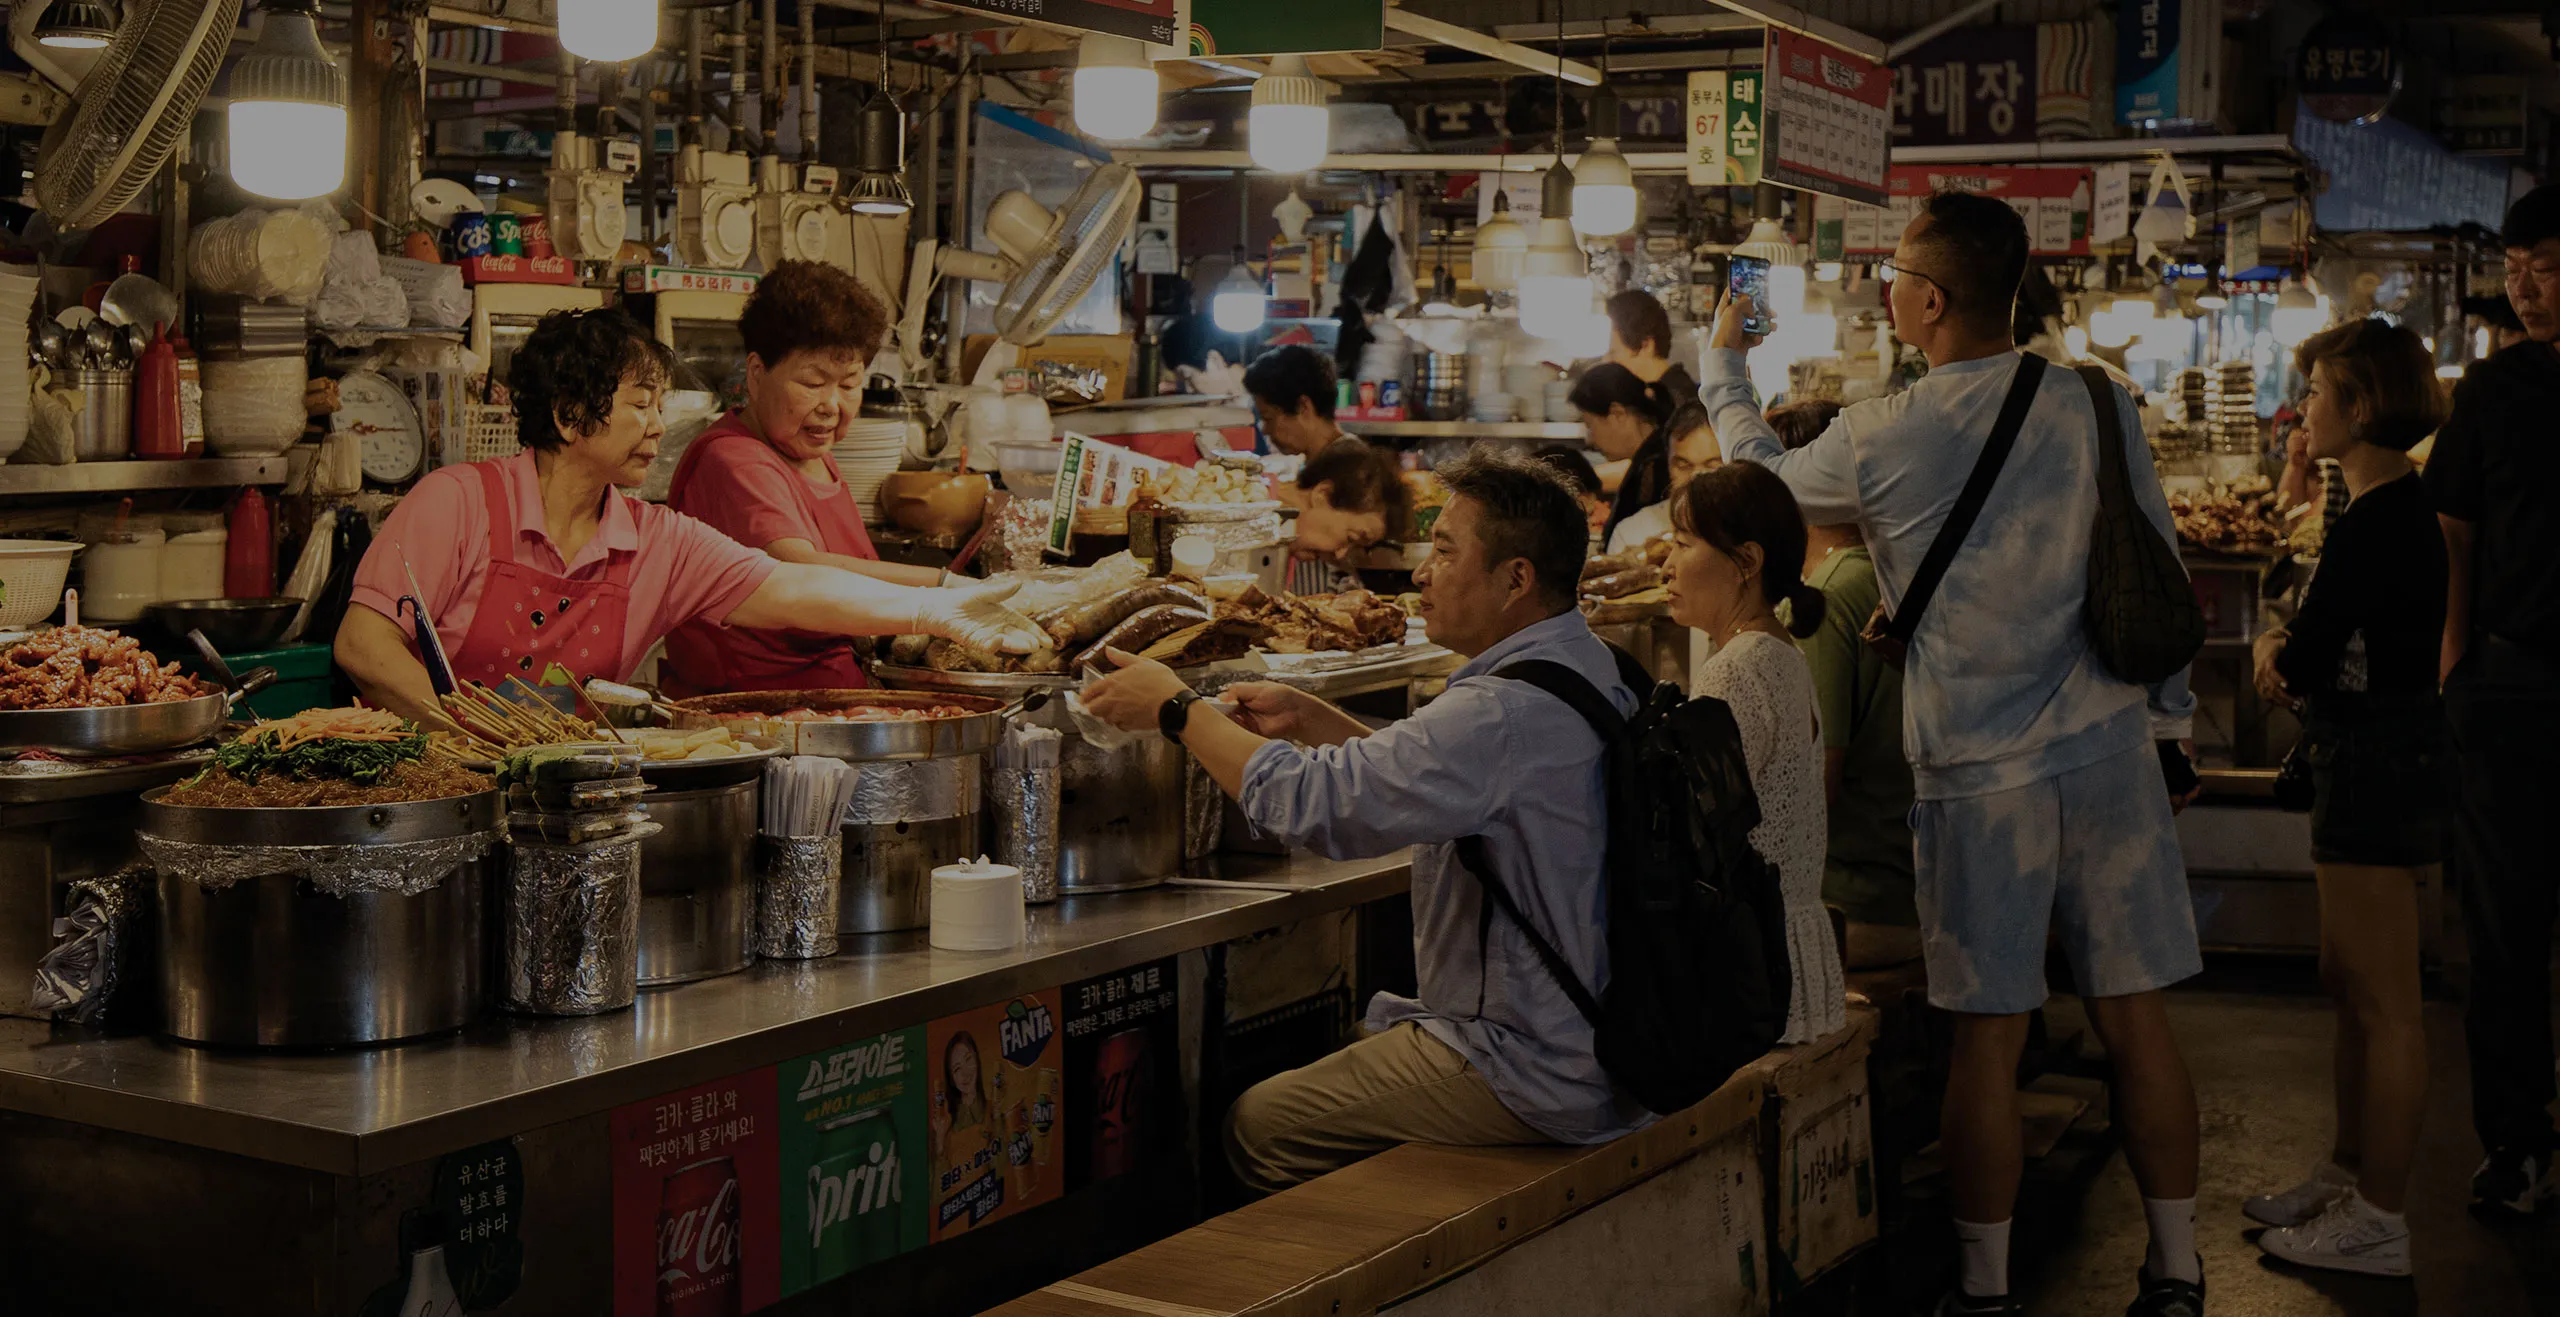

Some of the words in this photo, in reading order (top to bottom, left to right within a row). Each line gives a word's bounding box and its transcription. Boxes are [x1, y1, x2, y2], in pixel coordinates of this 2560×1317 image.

[2304, 44, 2389, 82] 유명도기
[1696, 115, 1718, 135] 67
[1697, 146, 1715, 164] 호
[1130, 967, 1161, 993] 제로
[1000, 1006, 1053, 1056] FANTA
[797, 1033, 905, 1102] 스프라이트
[639, 1132, 695, 1168] 짜릿하게
[698, 1115, 754, 1152] 즐기세요!
[458, 1156, 507, 1186] 유산균
[459, 1184, 508, 1216] 발효를
